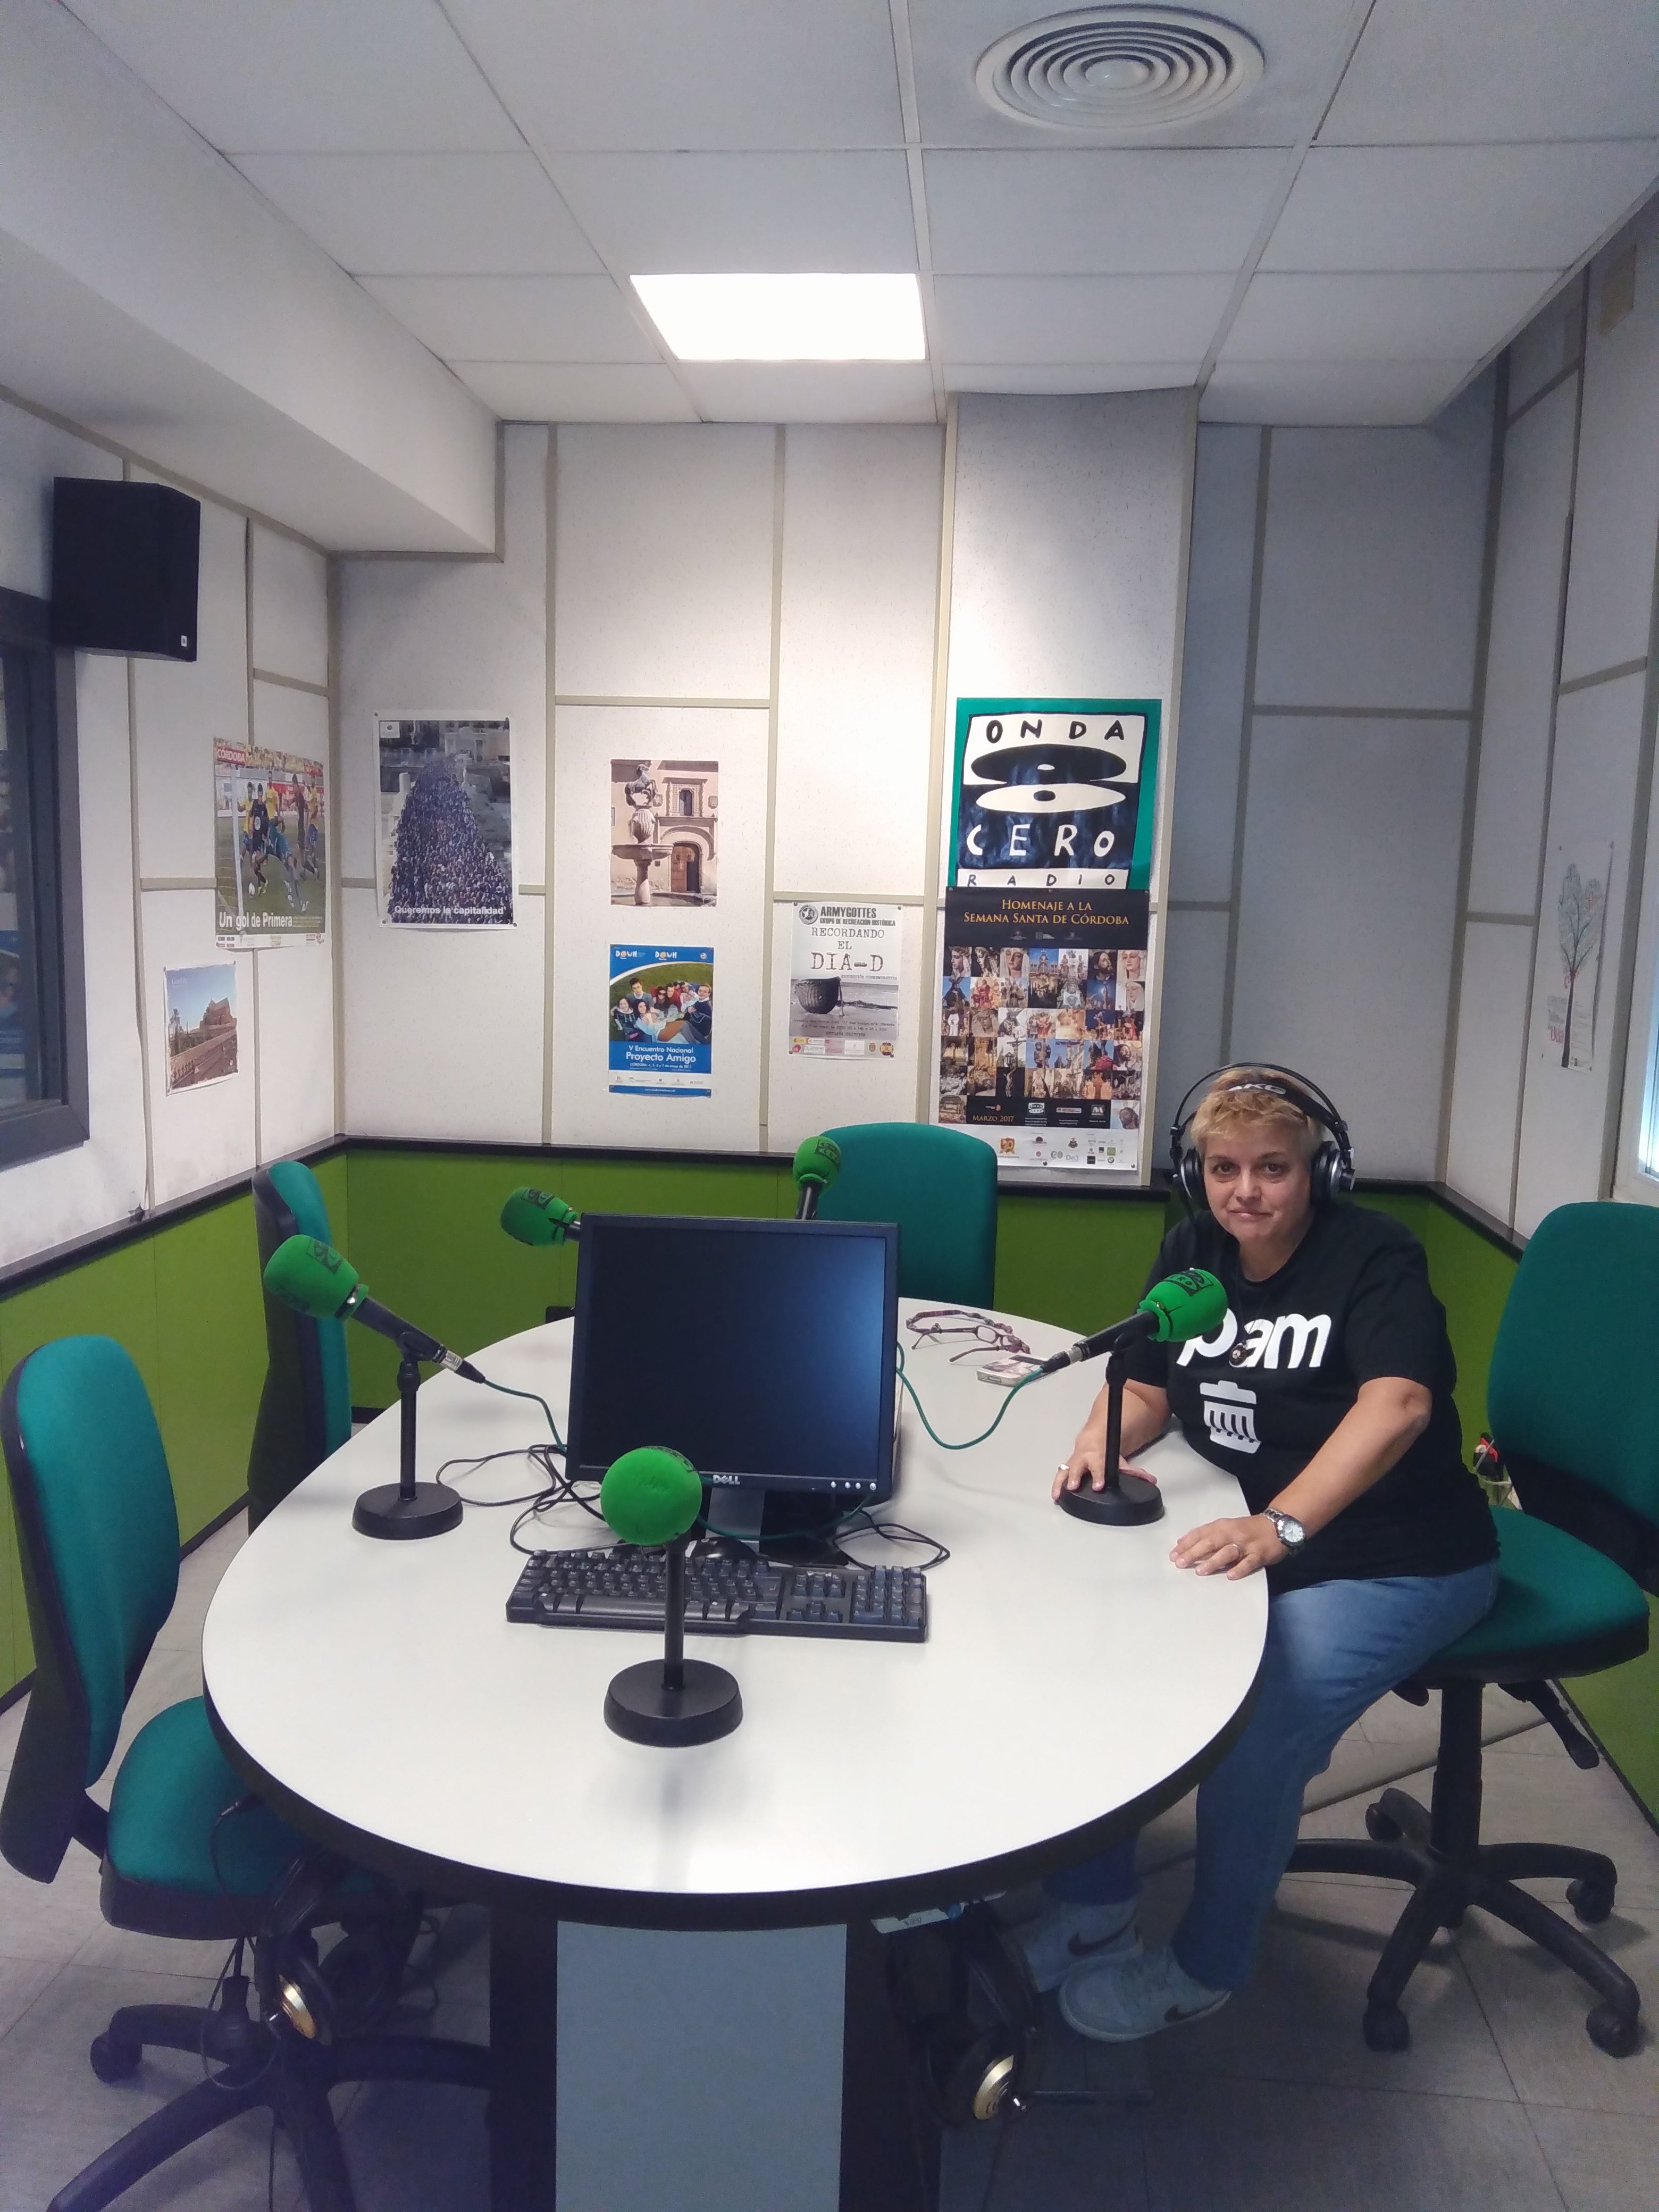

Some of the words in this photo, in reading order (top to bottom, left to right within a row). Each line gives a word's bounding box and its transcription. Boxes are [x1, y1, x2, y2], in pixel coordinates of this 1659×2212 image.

[986, 719, 1125, 744] ONDA
[217, 747, 245, 763] CÓRDOBA
[966, 824, 1115, 857] CERO
[967, 874, 1115, 886] RADIO
[394, 906, 440, 914] Queremos
[443, 906, 451, 914] la
[820, 906, 876, 918] ARMYGOTTES
[1067, 901, 1075, 910] A
[1079, 902, 1092, 911] LA
[219, 911, 232, 927] Un
[236, 911, 249, 931] gol
[251, 911, 261, 927] de
[263, 912, 292, 927] Primera
[1053, 914, 1067, 924] DE
[811, 927, 885, 939] RECORDANDO
[837, 941, 852, 949] EL
[626, 1051, 664, 1062] Proyecto
[666, 1053, 696, 1064] Amigo
[713, 1474, 741, 1485] DELL
